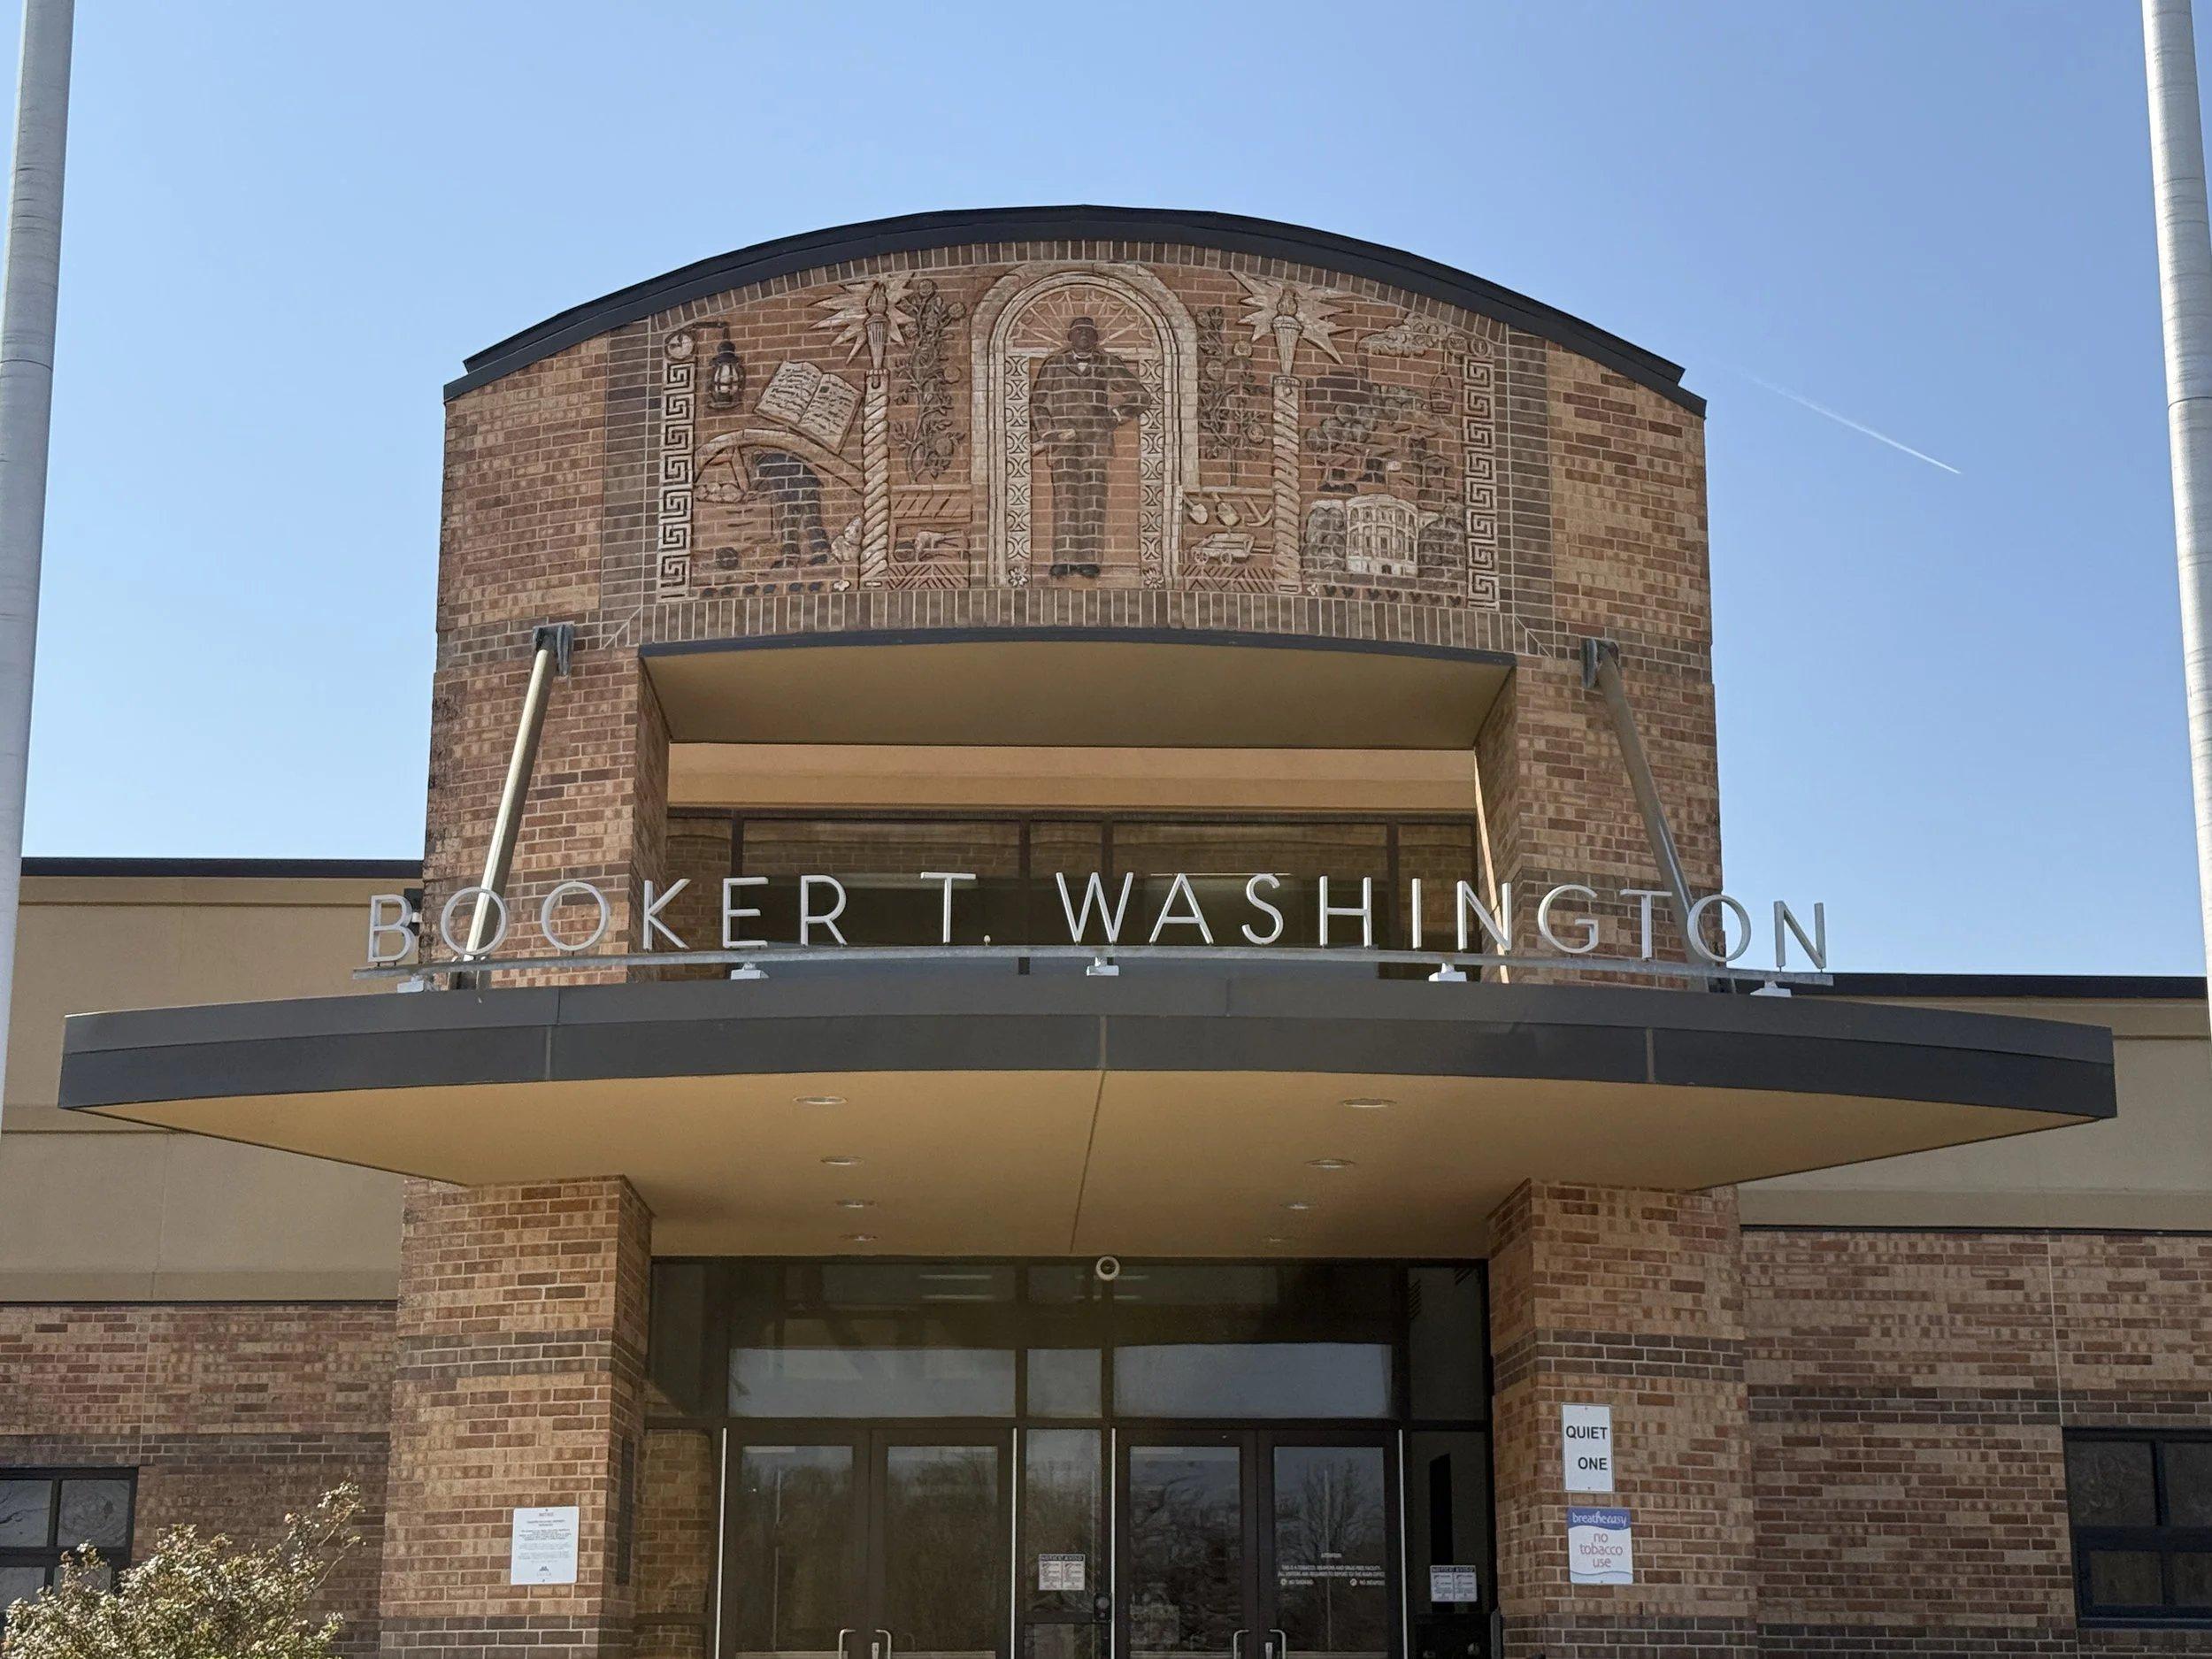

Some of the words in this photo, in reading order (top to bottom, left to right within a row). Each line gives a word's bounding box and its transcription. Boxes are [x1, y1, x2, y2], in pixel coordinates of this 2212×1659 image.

[368, 874, 847, 963] BOOKER
[921, 872, 991, 943] T.
[1056, 872, 1826, 969] WASHINGTON
[1565, 1425, 1608, 1440] QUIET
[1578, 1456, 1609, 1471] ONE
[1593, 1532, 1609, 1543] no
[1579, 1542, 1624, 1555] tobacco
[1593, 1557, 1612, 1568] use
